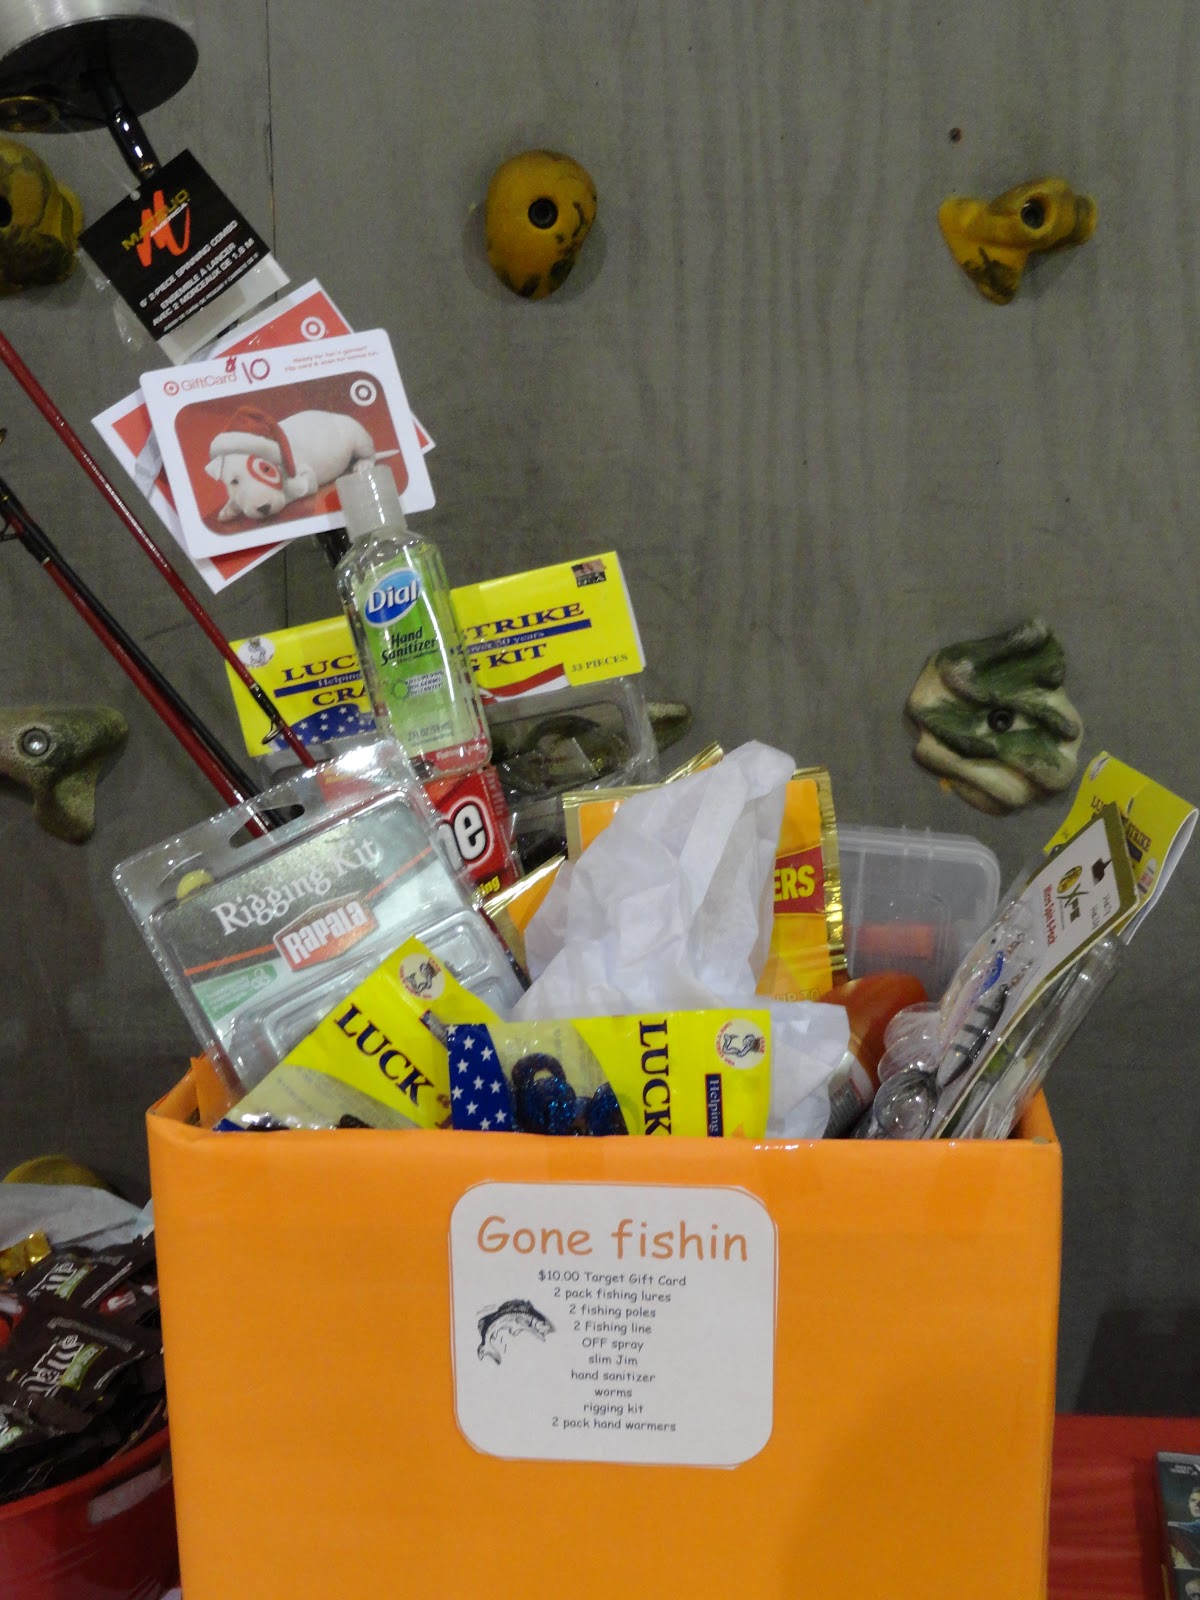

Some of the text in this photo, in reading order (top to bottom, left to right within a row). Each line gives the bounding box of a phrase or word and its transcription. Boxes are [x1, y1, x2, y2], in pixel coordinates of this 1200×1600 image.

[173, 243, 212, 277] SPINNING
[208, 219, 239, 247] COMBO
[150, 306, 174, 327] AVEC
[171, 300, 180, 310] 2
[178, 266, 222, 305] MORCEAUX
[219, 257, 233, 270] DE
[243, 237, 255, 248] M
[159, 273, 201, 310] ENSEMBLE
[204, 241, 237, 271] LANCER
[368, 580, 418, 614] Dial
[463, 602, 585, 642] TRIKE
[391, 626, 423, 649] Hand
[381, 637, 438, 667] Sanitizer
[486, 643, 548, 669] KIT
[586, 654, 629, 670] PIECES
[211, 836, 380, 936] Rigging Kit
[333, 1002, 434, 1107] LUCK
[639, 1019, 672, 1136] LUCK
[708, 1079, 721, 1133] Helping
[477, 1216, 748, 1261] Gone fishin
[538, 1270, 686, 1286] $10.00 Target Gift Card
[553, 1287, 671, 1303] 2 pack fishing lures
[569, 1304, 656, 1319] 2 fishing poles
[573, 1321, 652, 1335] 2 Fishing line
[582, 1338, 644, 1353] OFF spray
[588, 1354, 638, 1365] slim Jim
[571, 1369, 656, 1382] hand sanitizer
[594, 1388, 632, 1398] worms
[583, 1403, 643, 1416] rigging kit
[552, 1417, 676, 1432] 2 pack hand warmers
